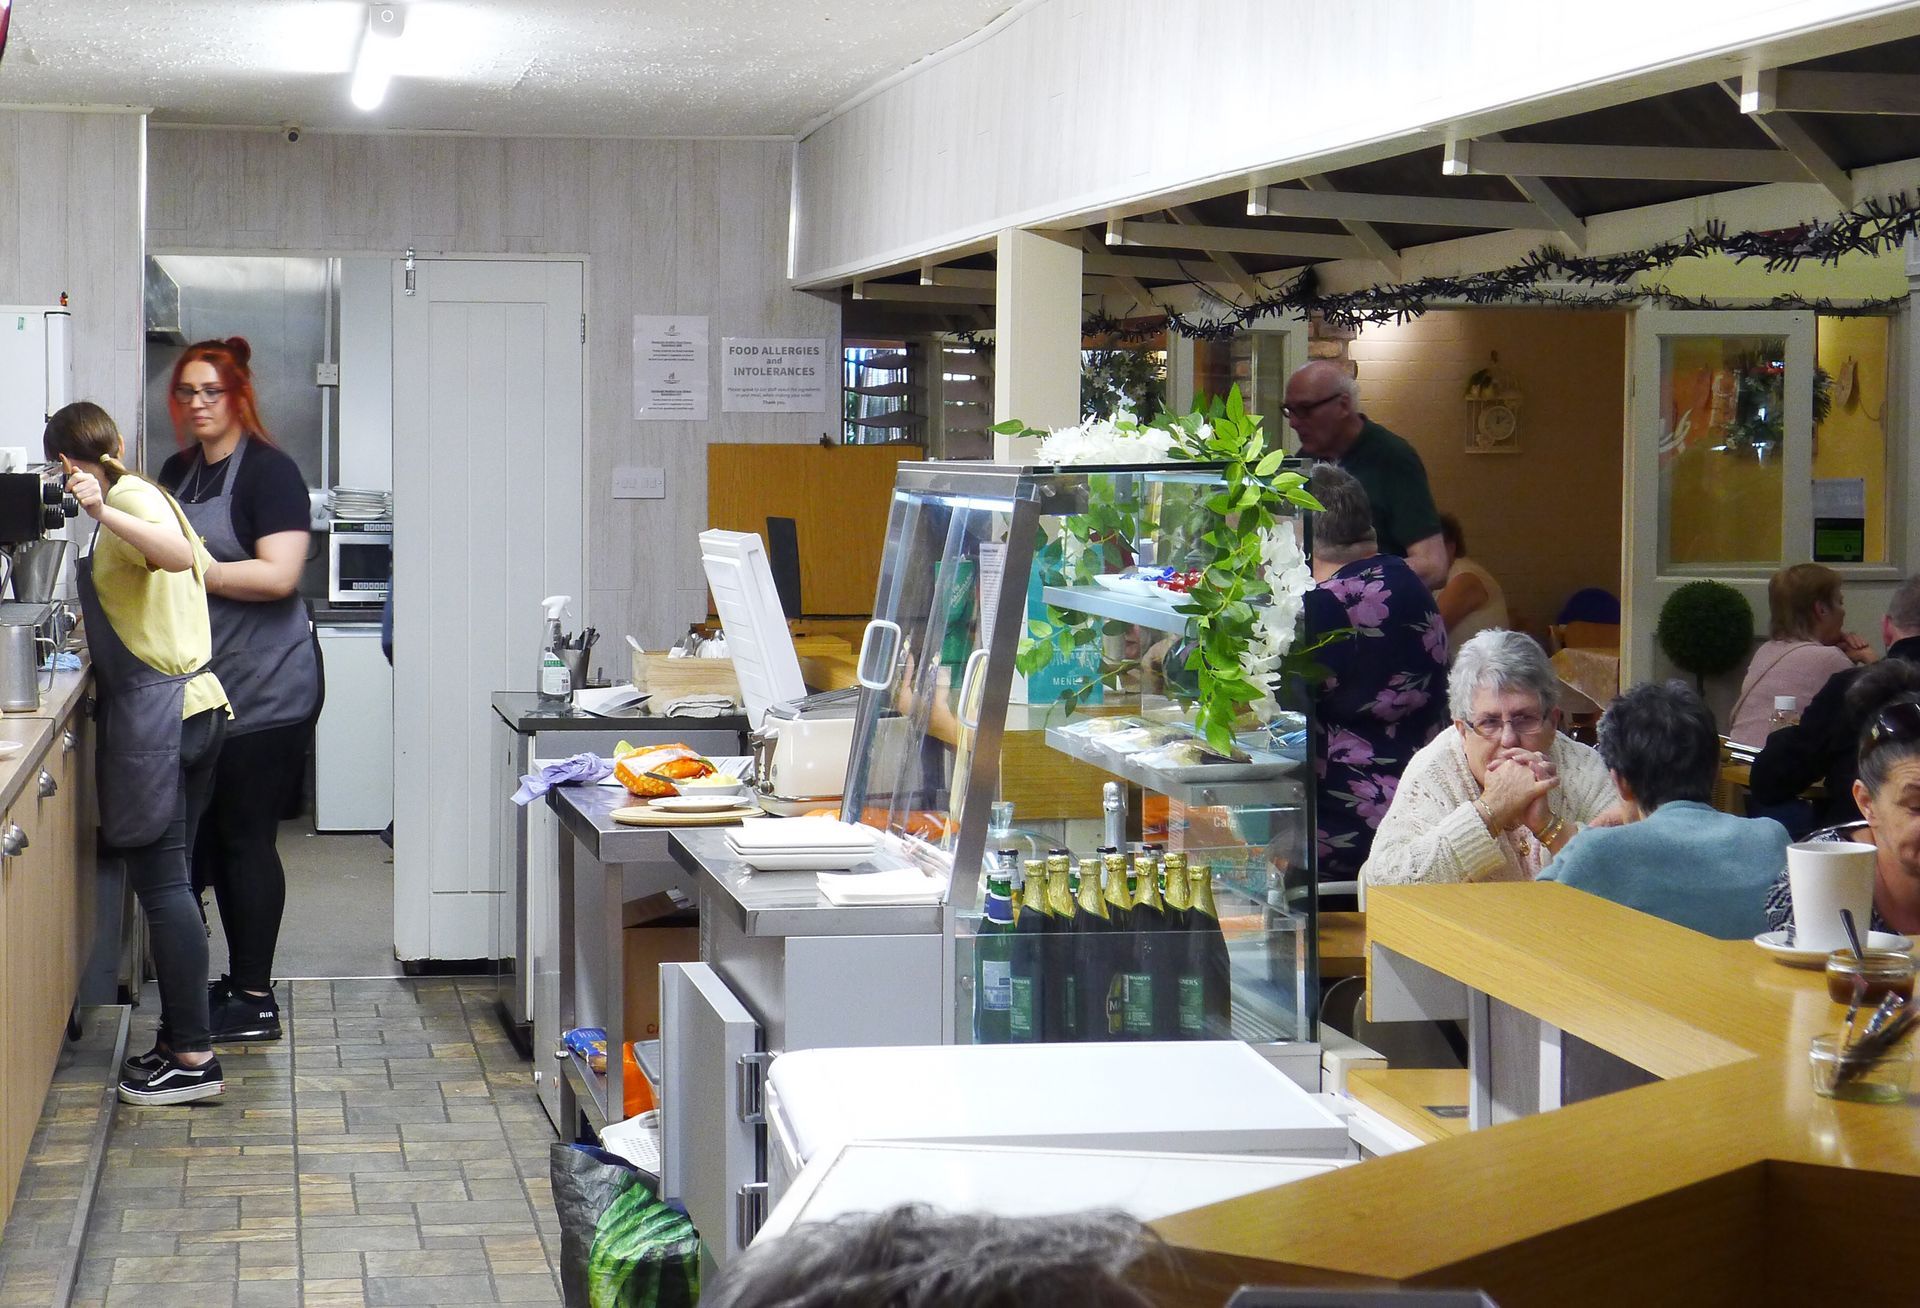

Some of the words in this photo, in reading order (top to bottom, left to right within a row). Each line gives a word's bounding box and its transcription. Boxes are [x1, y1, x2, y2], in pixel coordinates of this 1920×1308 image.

[729, 346, 759, 355] FOOD
[761, 346, 820, 355] ALLERGIES
[733, 367, 815, 376] INTOLERANCES
[259, 1011, 274, 1019] AIR
